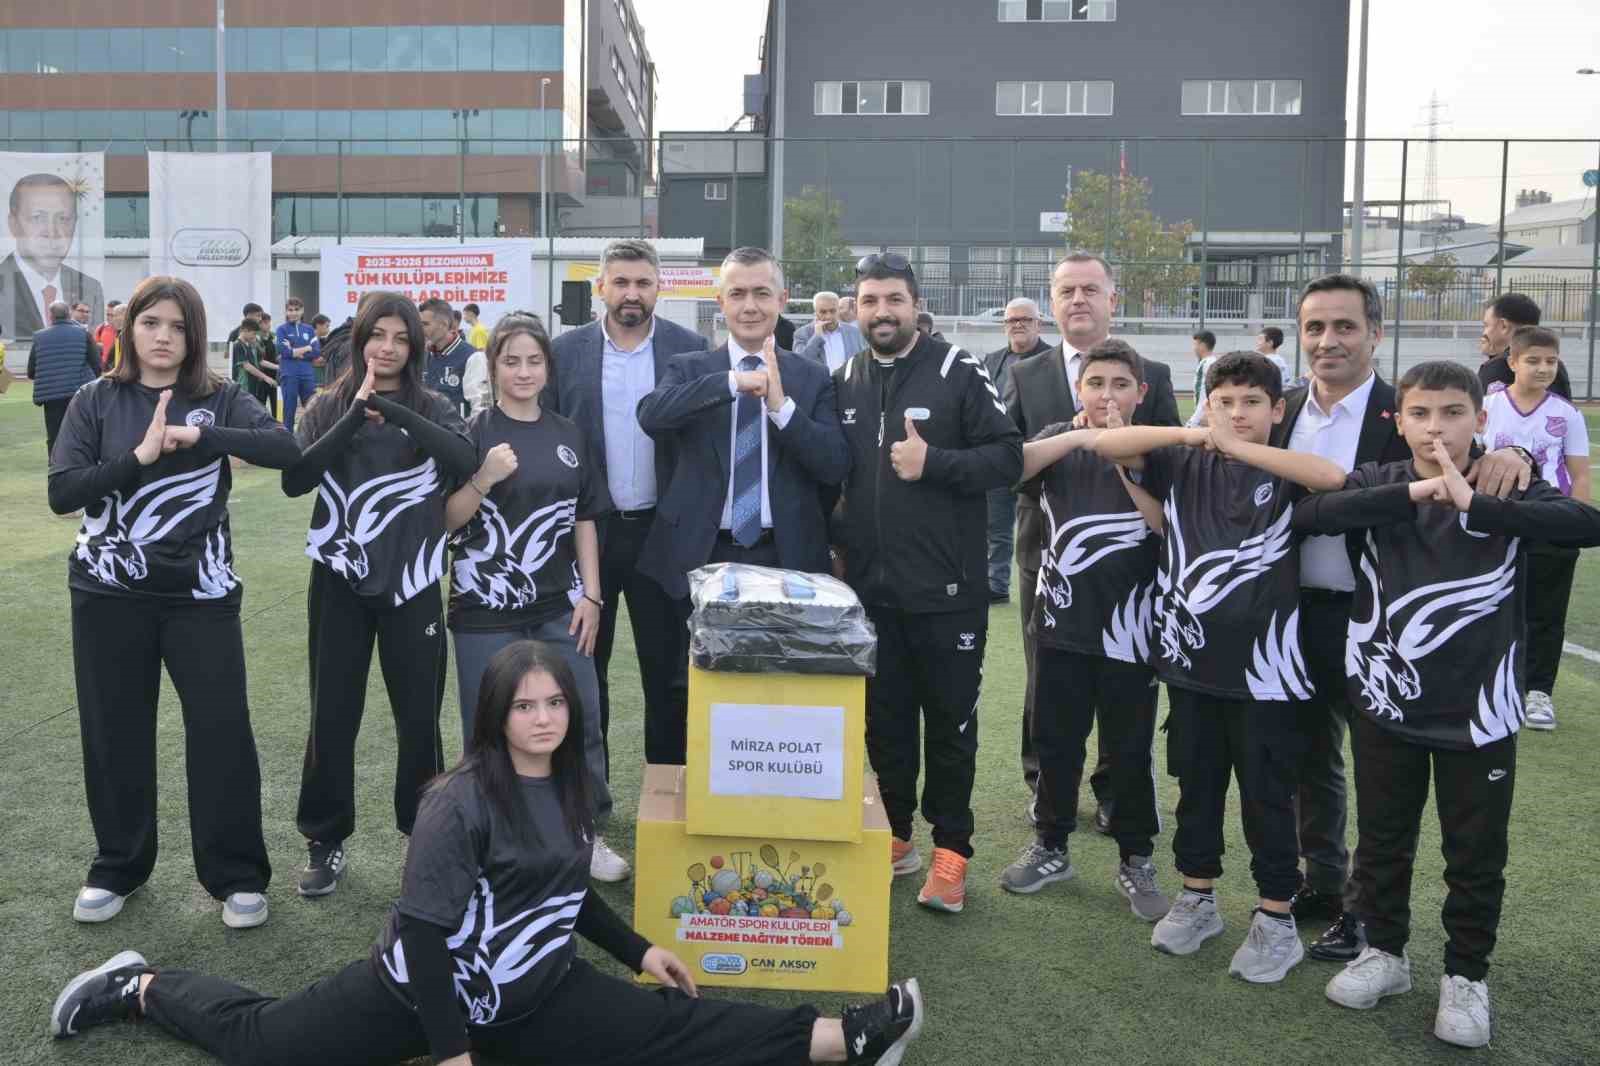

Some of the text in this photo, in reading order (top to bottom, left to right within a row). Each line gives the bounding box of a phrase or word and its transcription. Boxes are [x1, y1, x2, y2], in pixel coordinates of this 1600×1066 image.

[424, 256, 488, 266] SEZONUNDA
[344, 268, 508, 285] TÜM KULÜPLERİMİZE
[444, 286, 505, 302] DİLERİZ
[730, 738, 823, 754] MİRZA POLAT
[728, 759, 823, 774] SPOR KULÜBÜ
[689, 916, 831, 931] AMATÖR SPOR KULÜPLERİ
[686, 931, 833, 946] MALZEME DAĞITIM TÖRENİ
[751, 958, 775, 968] CAN
[779, 960, 817, 969] AKSOY
